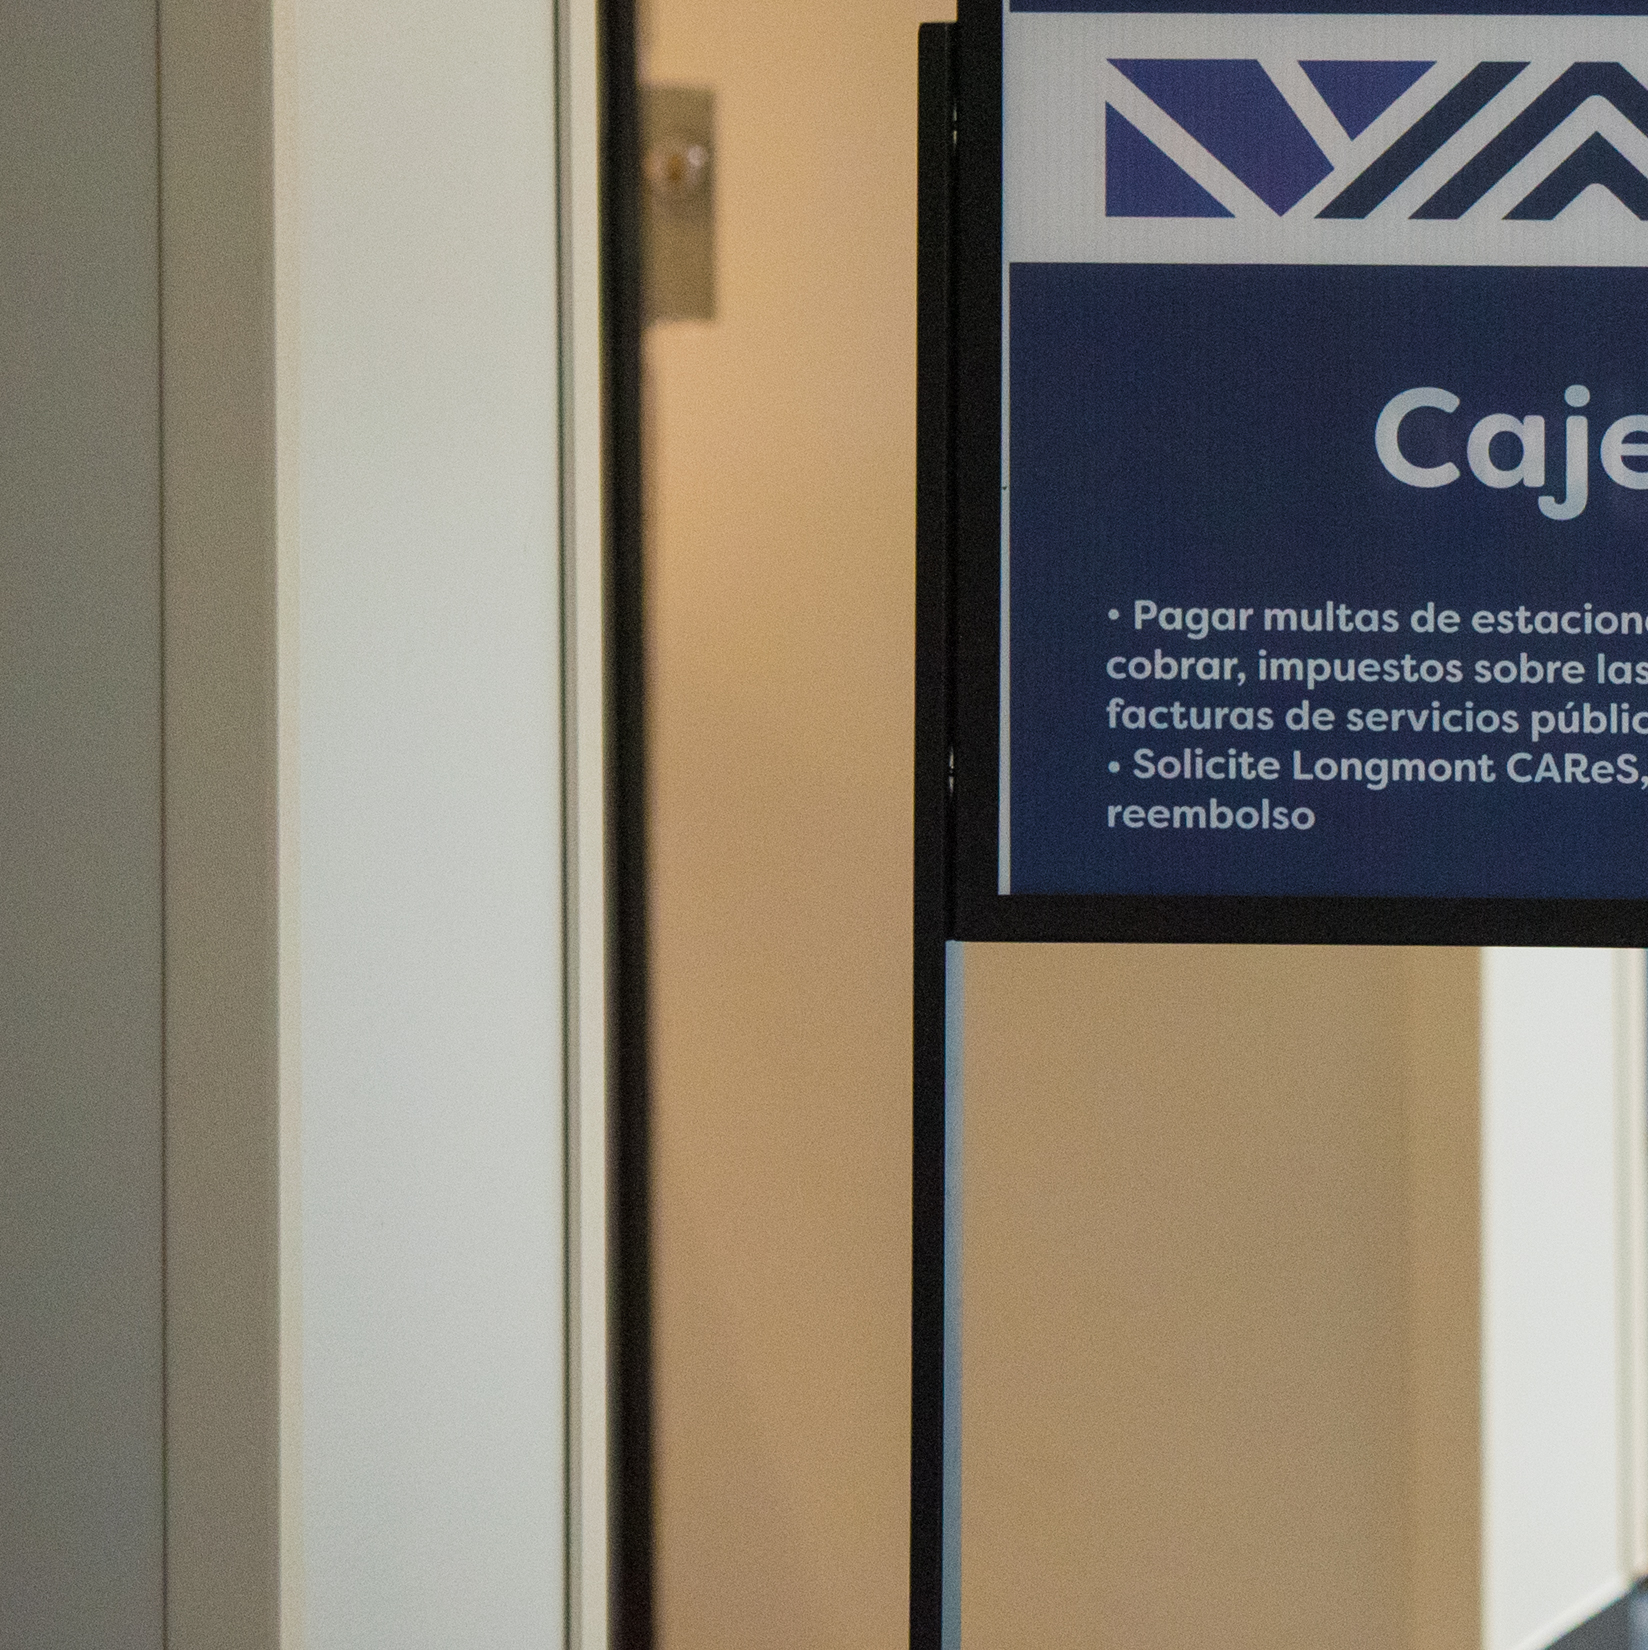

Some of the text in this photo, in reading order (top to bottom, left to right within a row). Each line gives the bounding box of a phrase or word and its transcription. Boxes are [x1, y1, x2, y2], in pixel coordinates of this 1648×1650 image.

[1132, 598, 1256, 642] Pagar
[1262, 599, 1401, 635] multas
[1408, 600, 1463, 635] de
[1104, 647, 1248, 687] cobrar,
[1257, 647, 1465, 692] impuestos
[1473, 650, 1587, 686] sobre
[1105, 695, 1276, 732] facturas
[1283, 698, 1337, 733] de
[1345, 699, 1521, 735] servicios
[1132, 746, 1282, 782] Solicite
[1291, 748, 1498, 792] Longmont
[1106, 796, 1317, 832] reembolso
